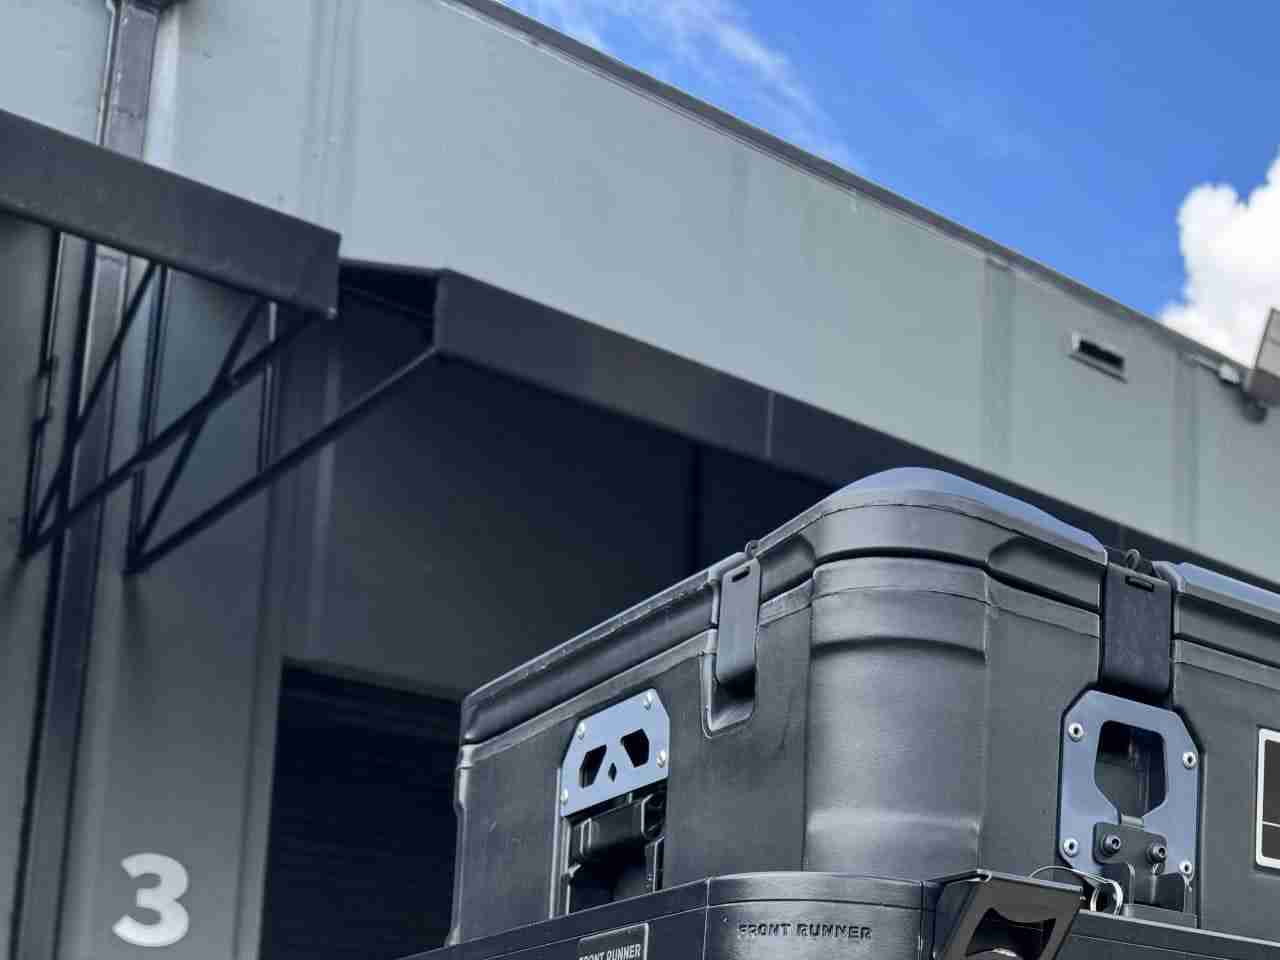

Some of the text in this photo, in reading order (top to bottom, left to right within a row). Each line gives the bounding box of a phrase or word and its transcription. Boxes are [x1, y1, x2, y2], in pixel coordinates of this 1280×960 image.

[112, 853, 188, 947] 3
[737, 922, 872, 941] FRONT RUNNER
